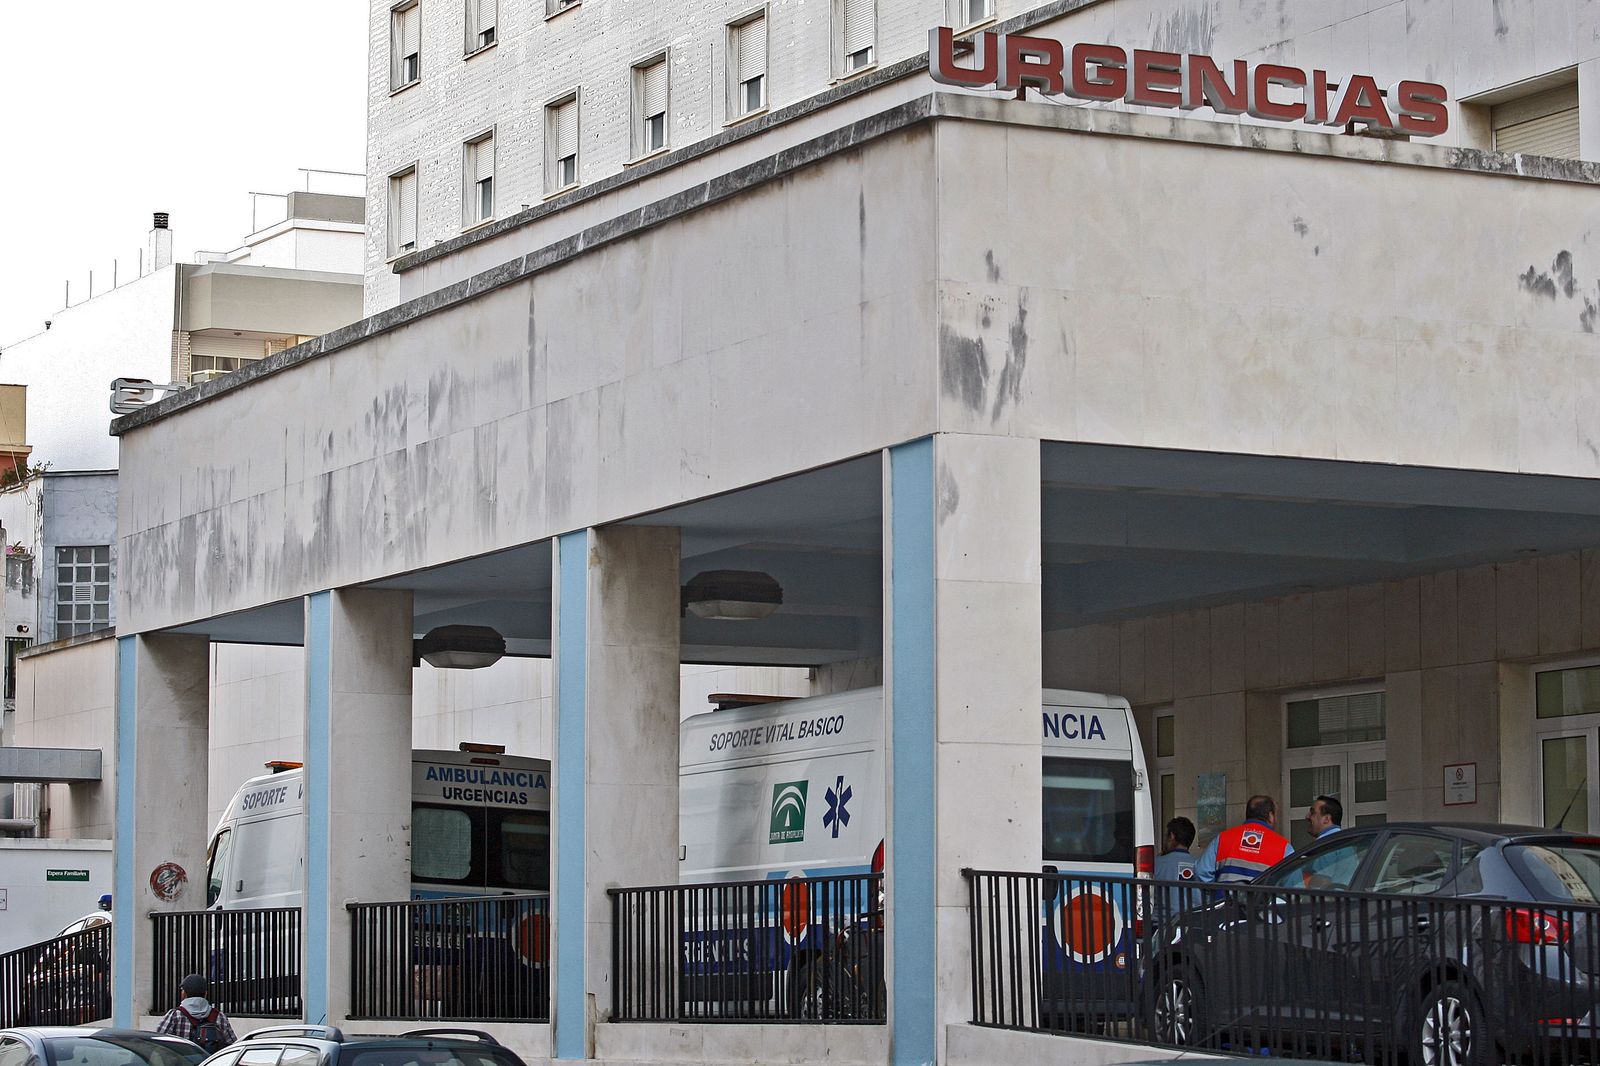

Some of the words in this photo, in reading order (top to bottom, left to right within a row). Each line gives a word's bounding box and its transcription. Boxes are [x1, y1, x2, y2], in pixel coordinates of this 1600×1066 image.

[929, 26, 1449, 137] URGENCIAS
[709, 726, 763, 752] SOPORTE
[765, 722, 795, 744] VITAL
[797, 714, 844, 739] BASICO
[1042, 712, 1106, 741] NCIA
[426, 766, 547, 790] AMBULANCIA
[242, 786, 288, 811] SOPORTE
[442, 786, 528, 805] URGENCIAS
